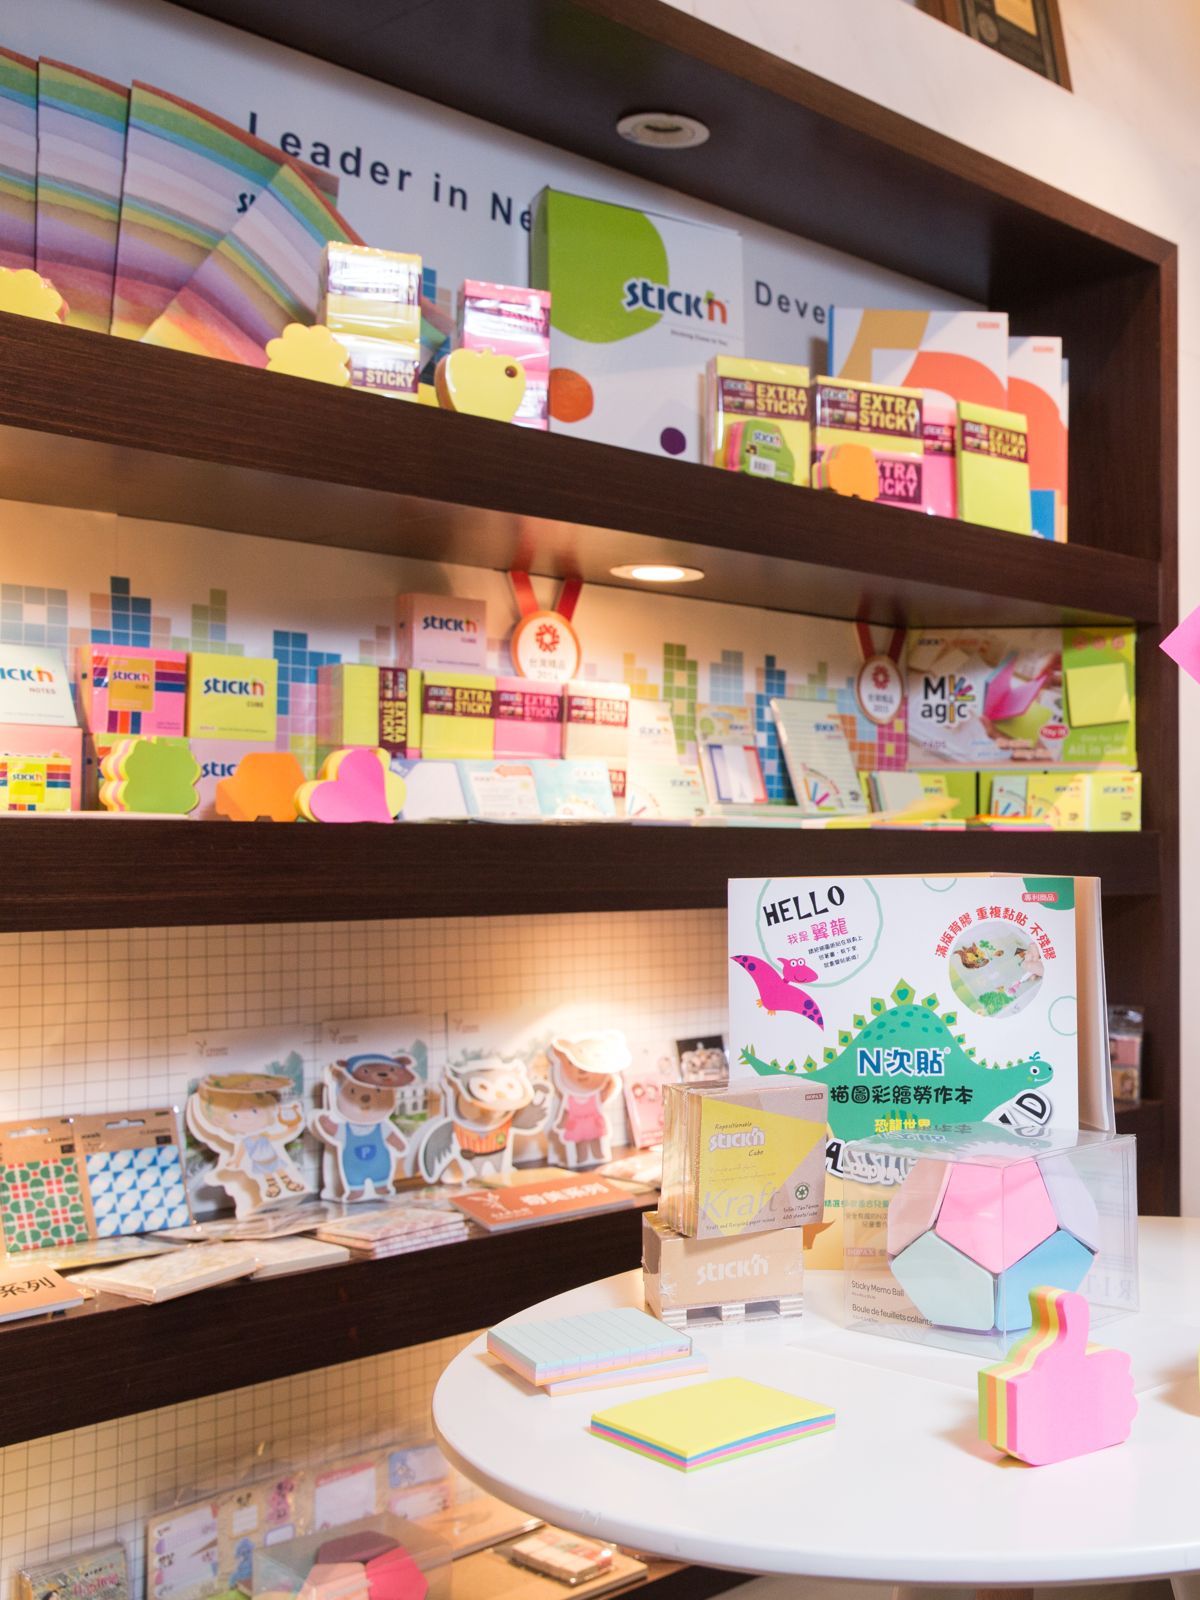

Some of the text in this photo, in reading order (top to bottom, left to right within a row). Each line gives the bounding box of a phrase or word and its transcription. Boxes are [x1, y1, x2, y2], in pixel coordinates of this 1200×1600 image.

[433, 173, 468, 211] in
[366, 367, 416, 389] STICKY
[756, 384, 808, 402] EXTRA
[859, 392, 919, 414] EXTRA
[756, 399, 808, 416] STICKY
[859, 409, 919, 432] STICKY
[455, 688, 492, 702] EXTRA
[524, 693, 559, 707] EXTRA
[455, 700, 492, 715] STICKY
[524, 706, 559, 719] STICKY
[762, 885, 845, 926] HELLO
[975, 905, 1029, 926] 重複黏貼
[1029, 923, 1057, 960] 不殘膠
[858, 1049, 943, 1075] N次貼
[830, 1085, 973, 1105] 描圖彩繪勞作本
[851, 1280, 870, 1292] Sticky
[870, 1284, 892, 1295] Memo
[892, 1287, 905, 1297] Ball
[852, 1303, 870, 1314] Boule
[870, 1308, 880, 1316] de
[880, 1309, 907, 1321] feuillets
[906, 1315, 933, 1327] collants
